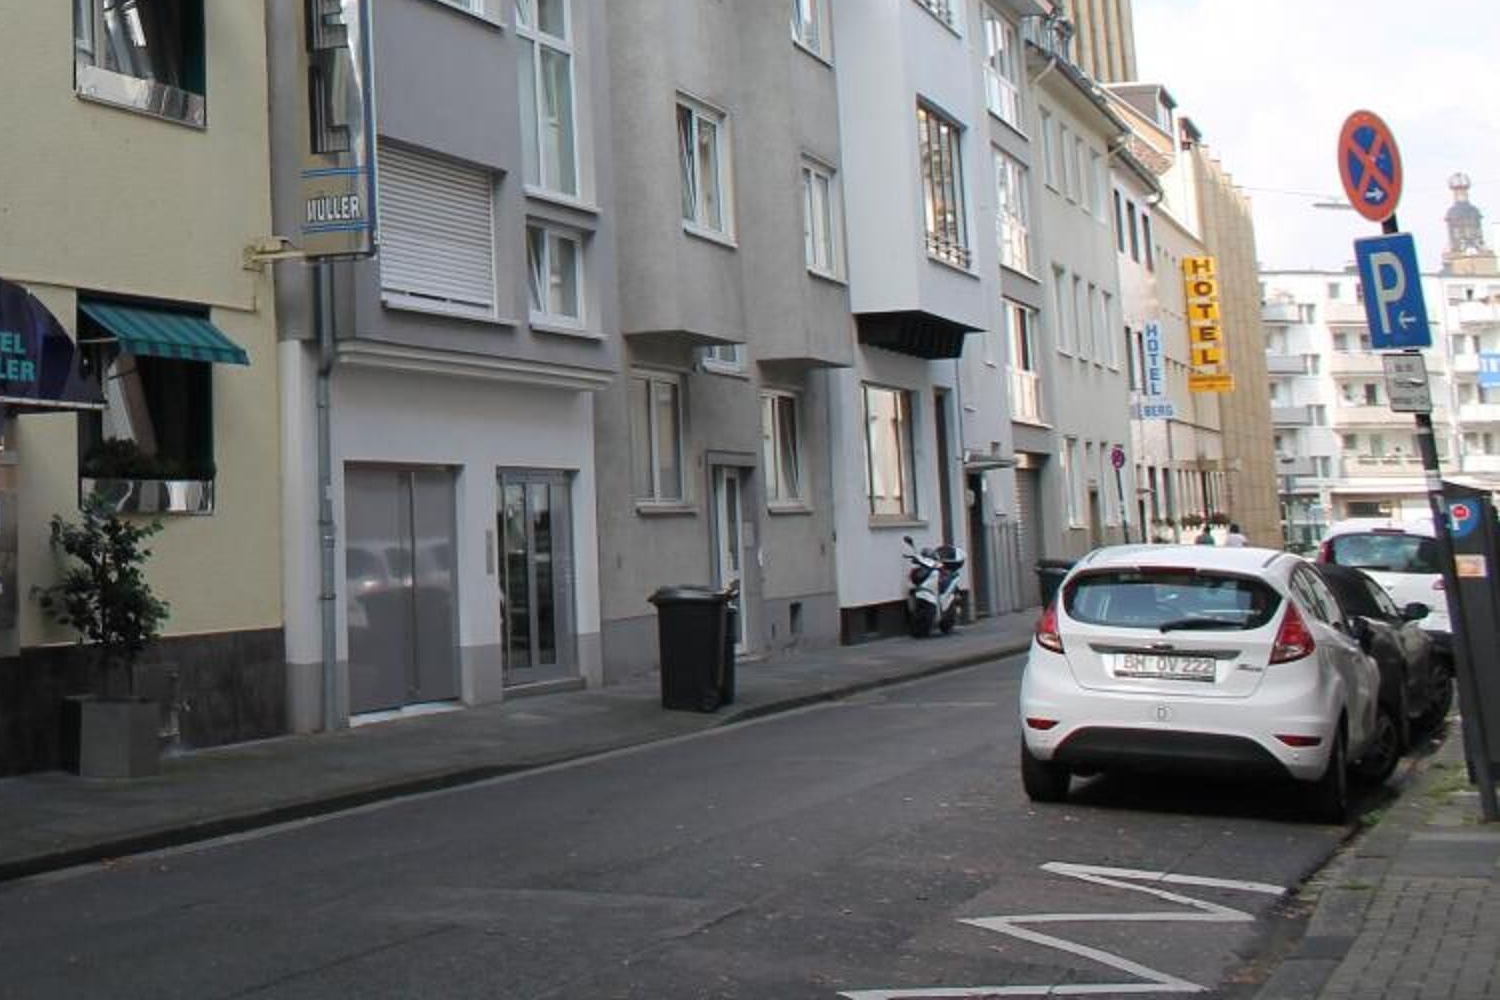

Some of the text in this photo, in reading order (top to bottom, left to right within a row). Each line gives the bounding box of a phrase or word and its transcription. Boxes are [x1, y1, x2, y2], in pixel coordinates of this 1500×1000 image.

[1191, 258, 1220, 366] HOTEL
[1369, 251, 1406, 335] P
[1145, 323, 1162, 395] HOTEL
